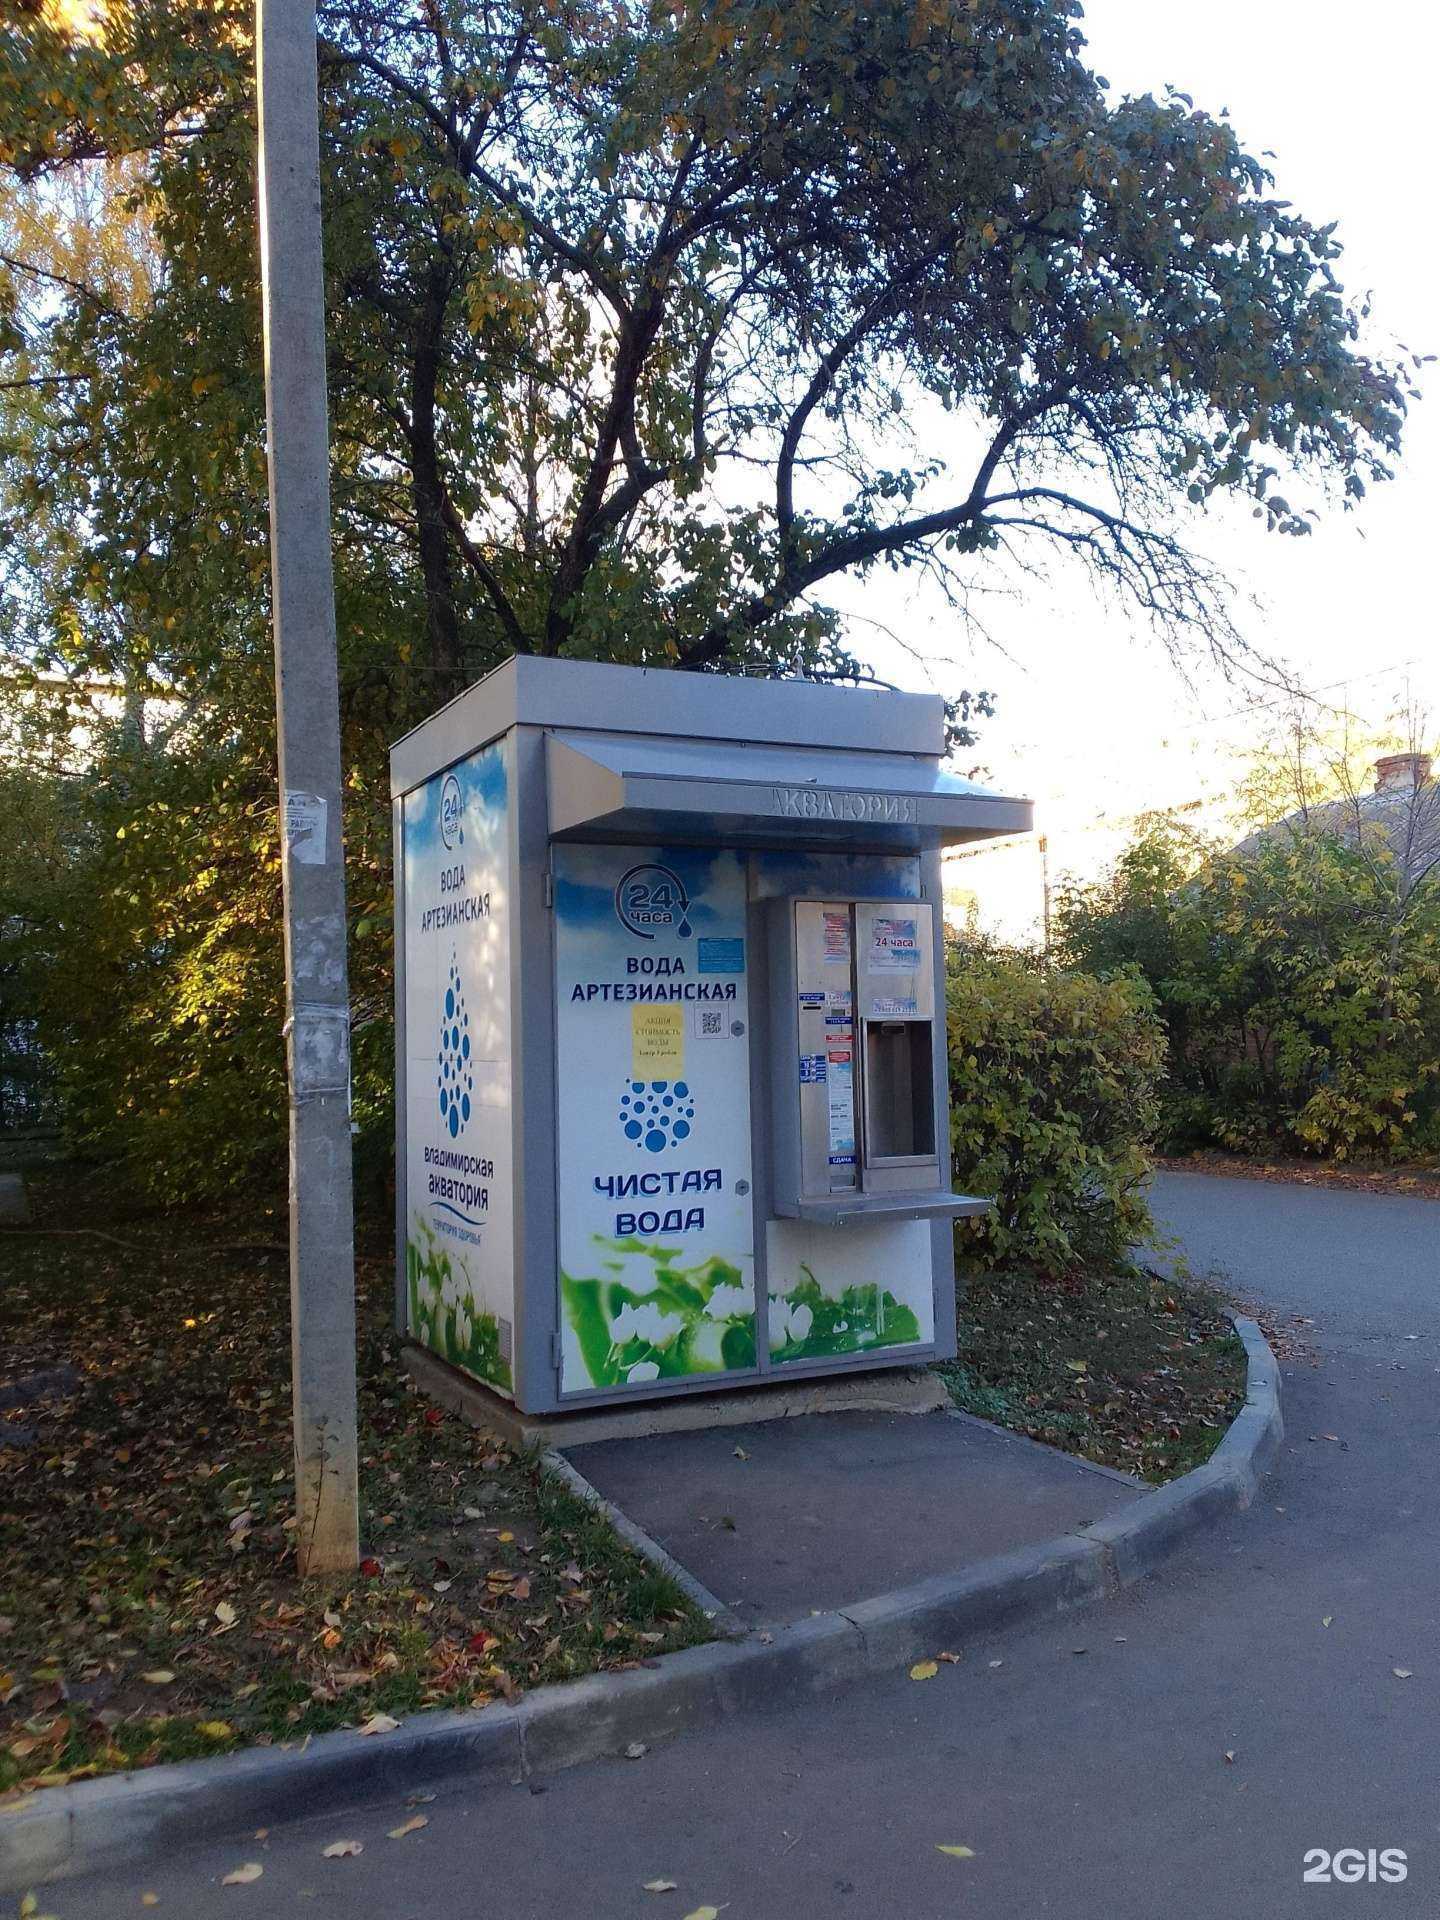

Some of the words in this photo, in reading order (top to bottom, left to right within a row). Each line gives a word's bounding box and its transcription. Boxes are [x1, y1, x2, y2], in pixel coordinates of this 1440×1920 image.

[444, 794, 457, 822] 24
[441, 864, 465, 892] ВОДА
[628, 884, 675, 910] 24
[421, 893, 490, 933] АРТЕЗИАНСКАЯ
[629, 911, 673, 924] часа
[875, 937, 888, 947] 24
[890, 938, 914, 948] часа
[626, 957, 685, 977] ВОДА
[571, 983, 737, 1001] АРТЕЗИАНСКАЯ
[424, 1146, 494, 1179] владимирская
[428, 1174, 489, 1211] акватория
[594, 1168, 722, 1198] ЧИСТАЯ
[614, 1207, 705, 1238] ВОДА
